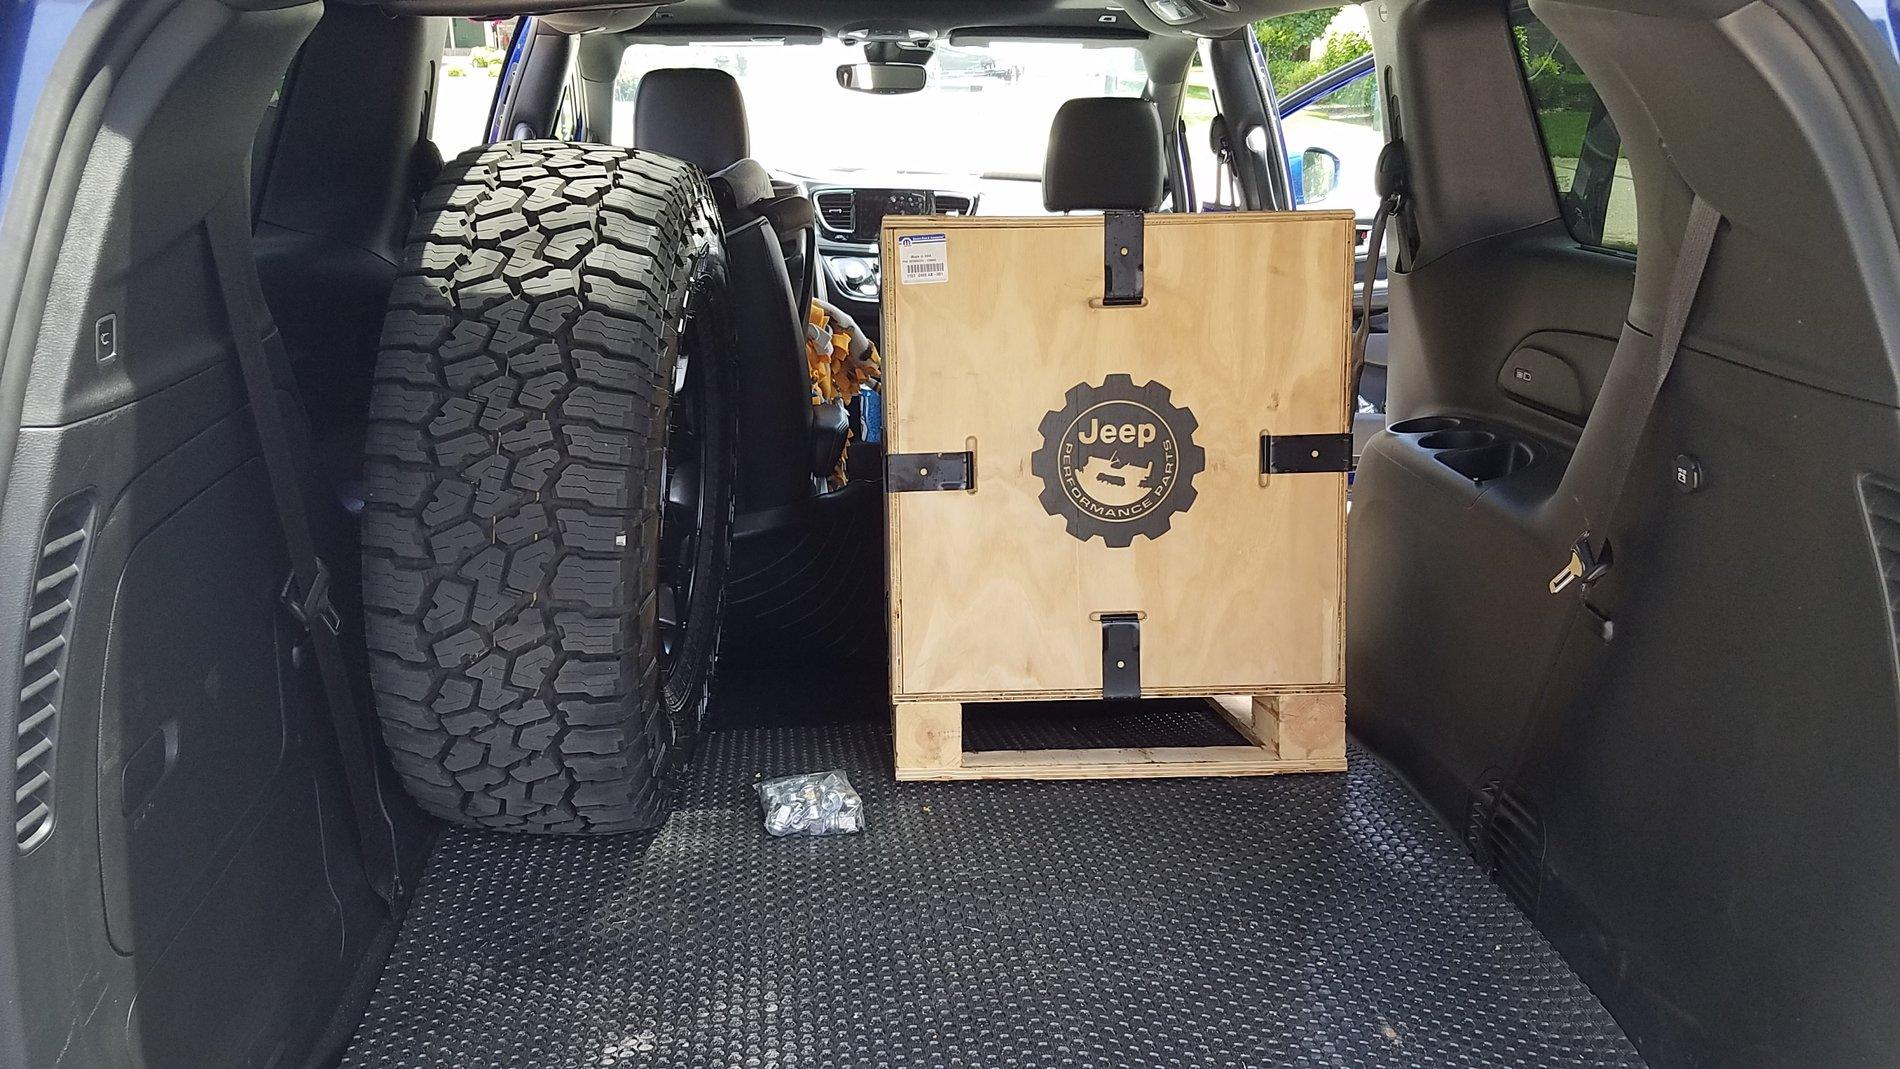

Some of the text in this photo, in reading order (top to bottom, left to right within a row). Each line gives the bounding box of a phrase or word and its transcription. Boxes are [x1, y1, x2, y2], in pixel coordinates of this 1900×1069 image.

[1078, 418, 1156, 448] Jeep
[1062, 439, 1174, 517] PERFORMANCE PARTS
